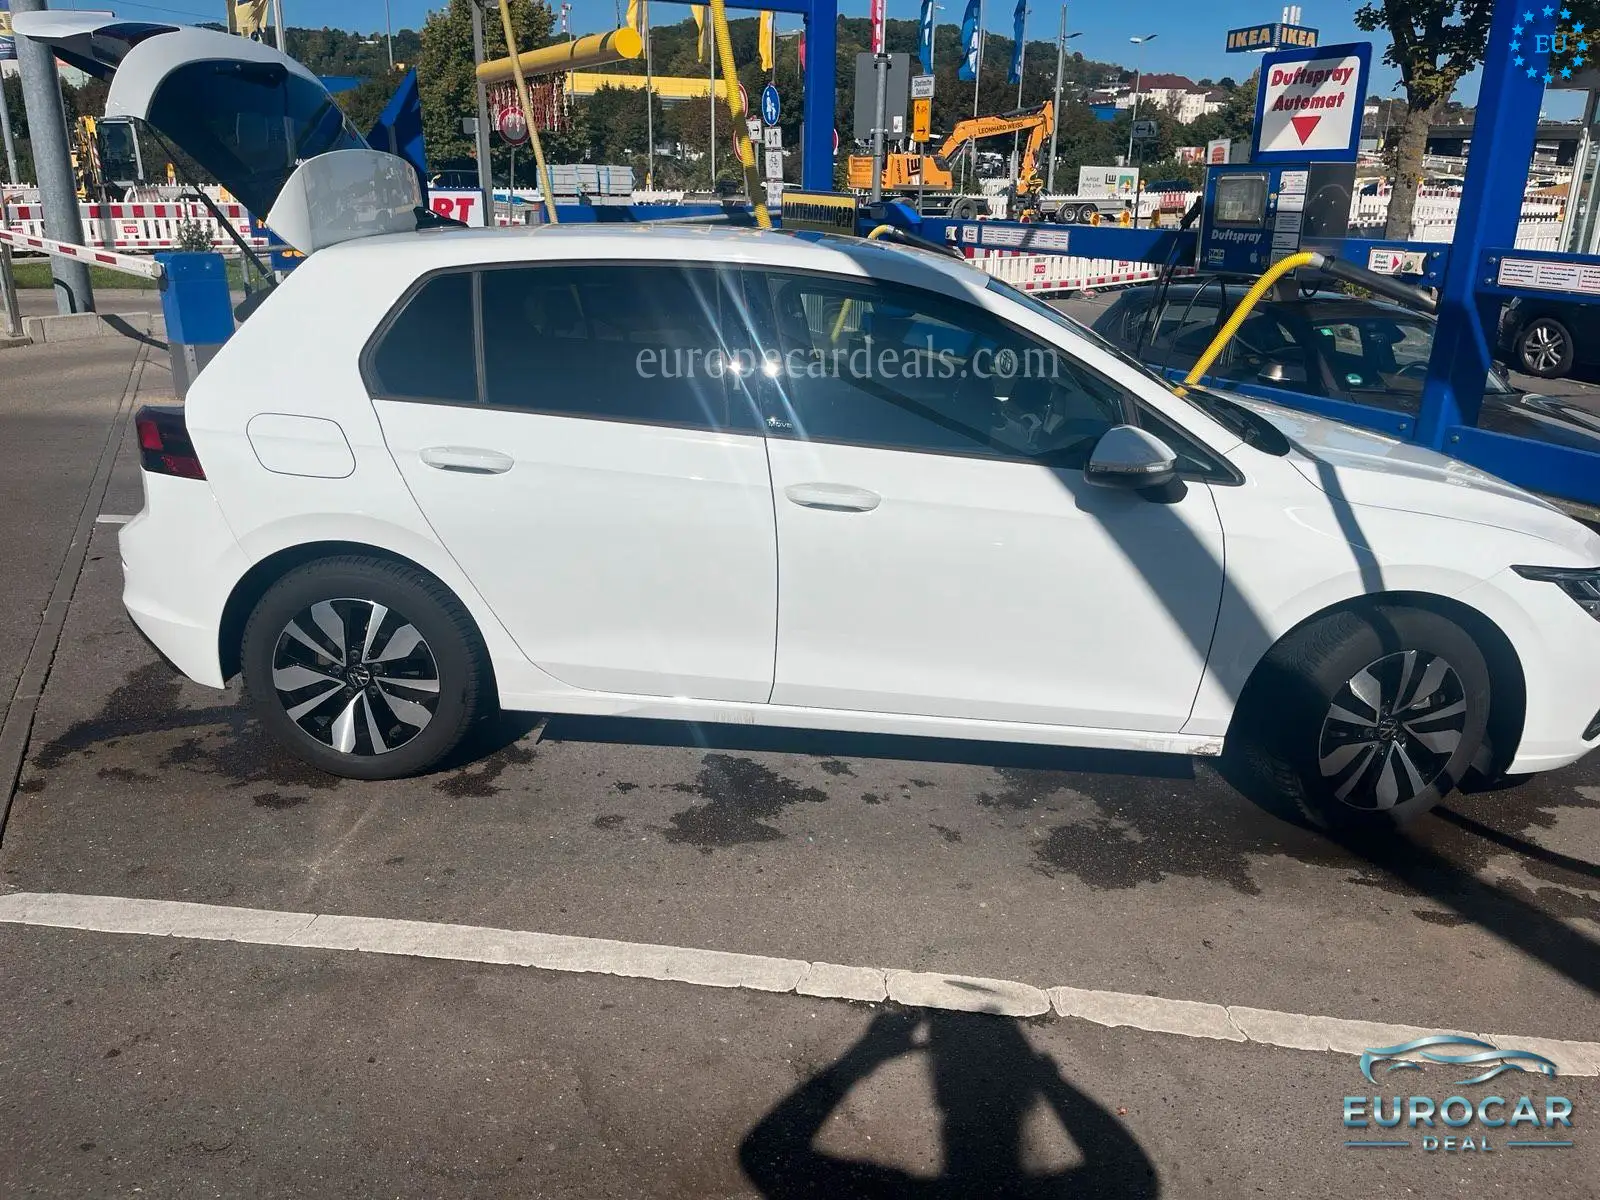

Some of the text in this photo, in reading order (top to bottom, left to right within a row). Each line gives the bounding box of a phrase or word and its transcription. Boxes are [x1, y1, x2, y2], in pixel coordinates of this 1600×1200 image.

[1228, 28, 1270, 48] IKEA
[1282, 27, 1316, 47] IKEA
[1271, 67, 1353, 87] Duftspray
[1272, 92, 1345, 111] Automat
[978, 124, 1007, 134] LEONHARD
[1211, 229, 1261, 244] Duftspray
